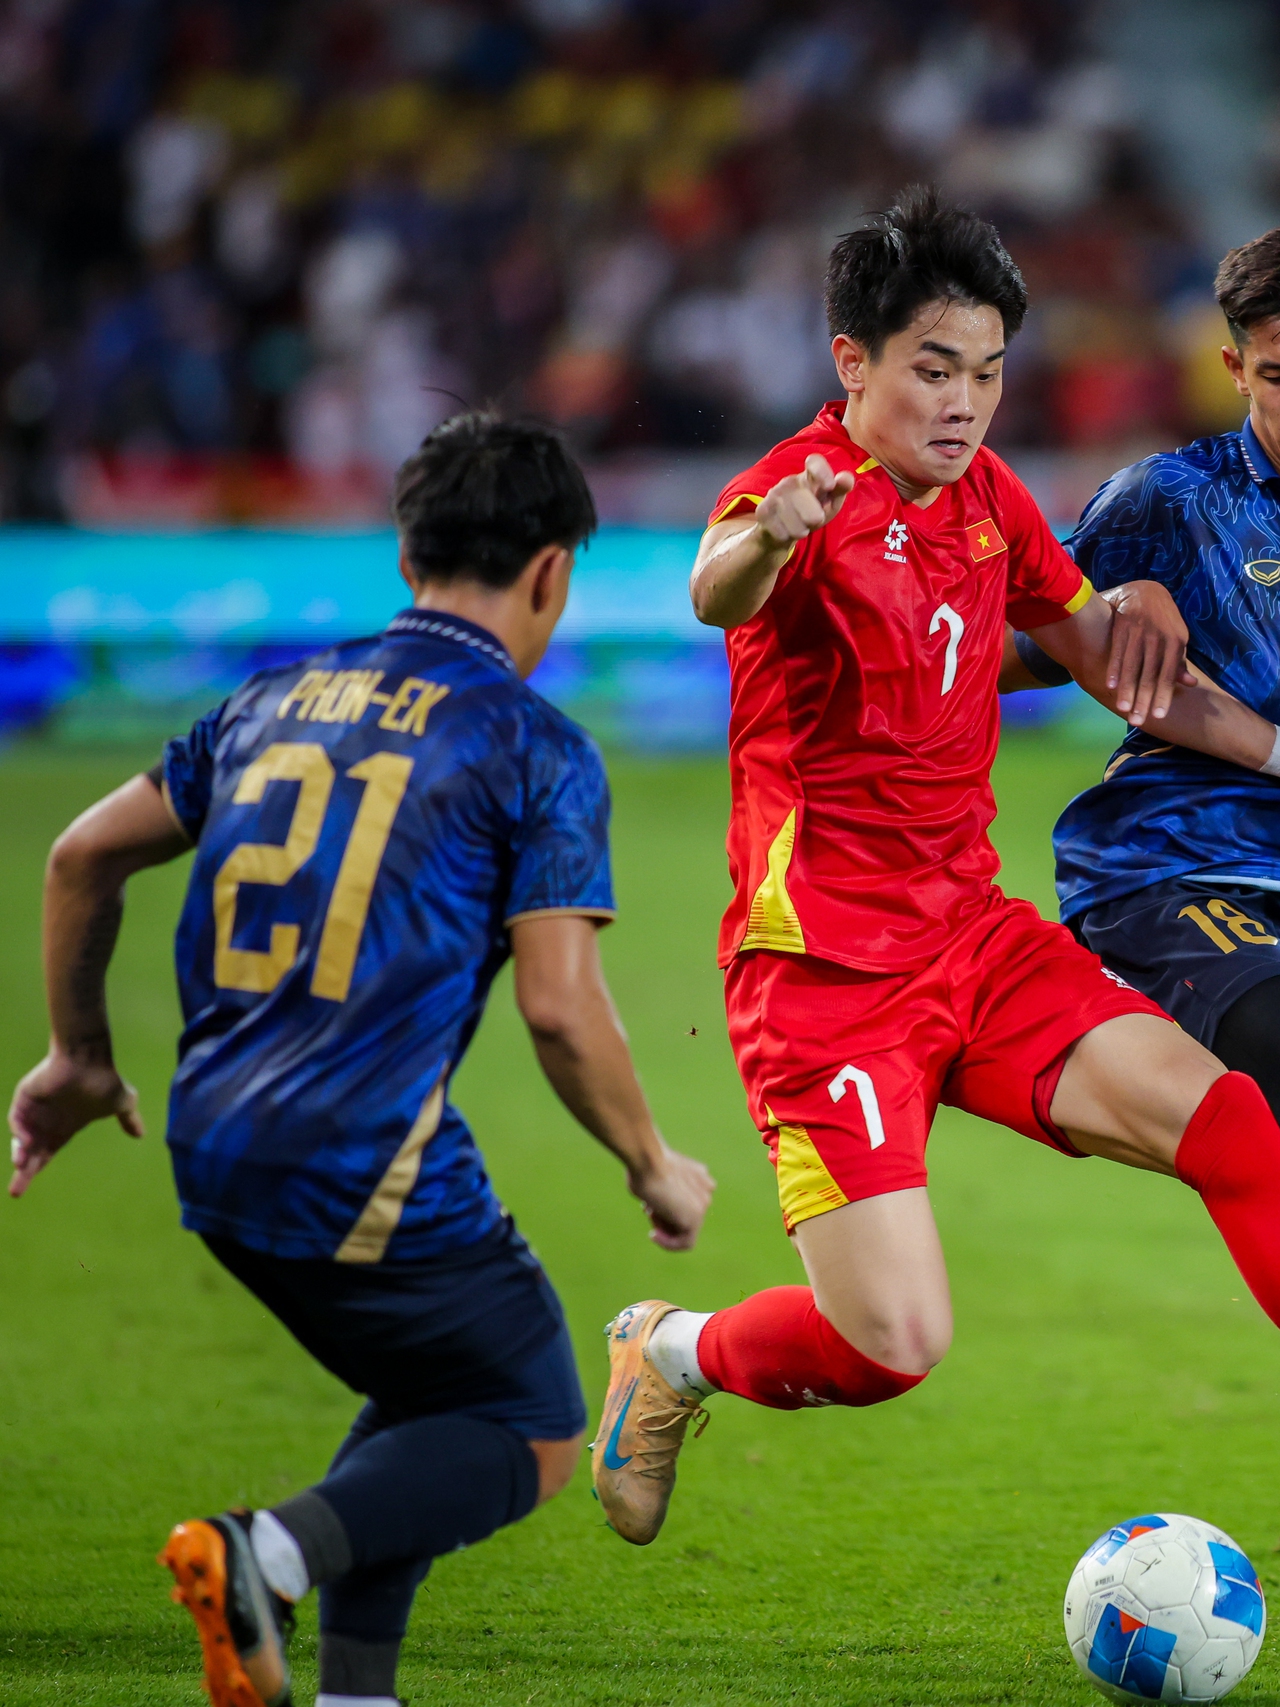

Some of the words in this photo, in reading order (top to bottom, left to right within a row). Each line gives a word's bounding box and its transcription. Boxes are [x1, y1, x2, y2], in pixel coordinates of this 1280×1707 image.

[928, 602, 965, 697] 7
[277, 669, 450, 737] PHON-EK
[214, 742, 414, 1002] 21
[1178, 898, 1279, 955] 18
[827, 1063, 886, 1151] 7
